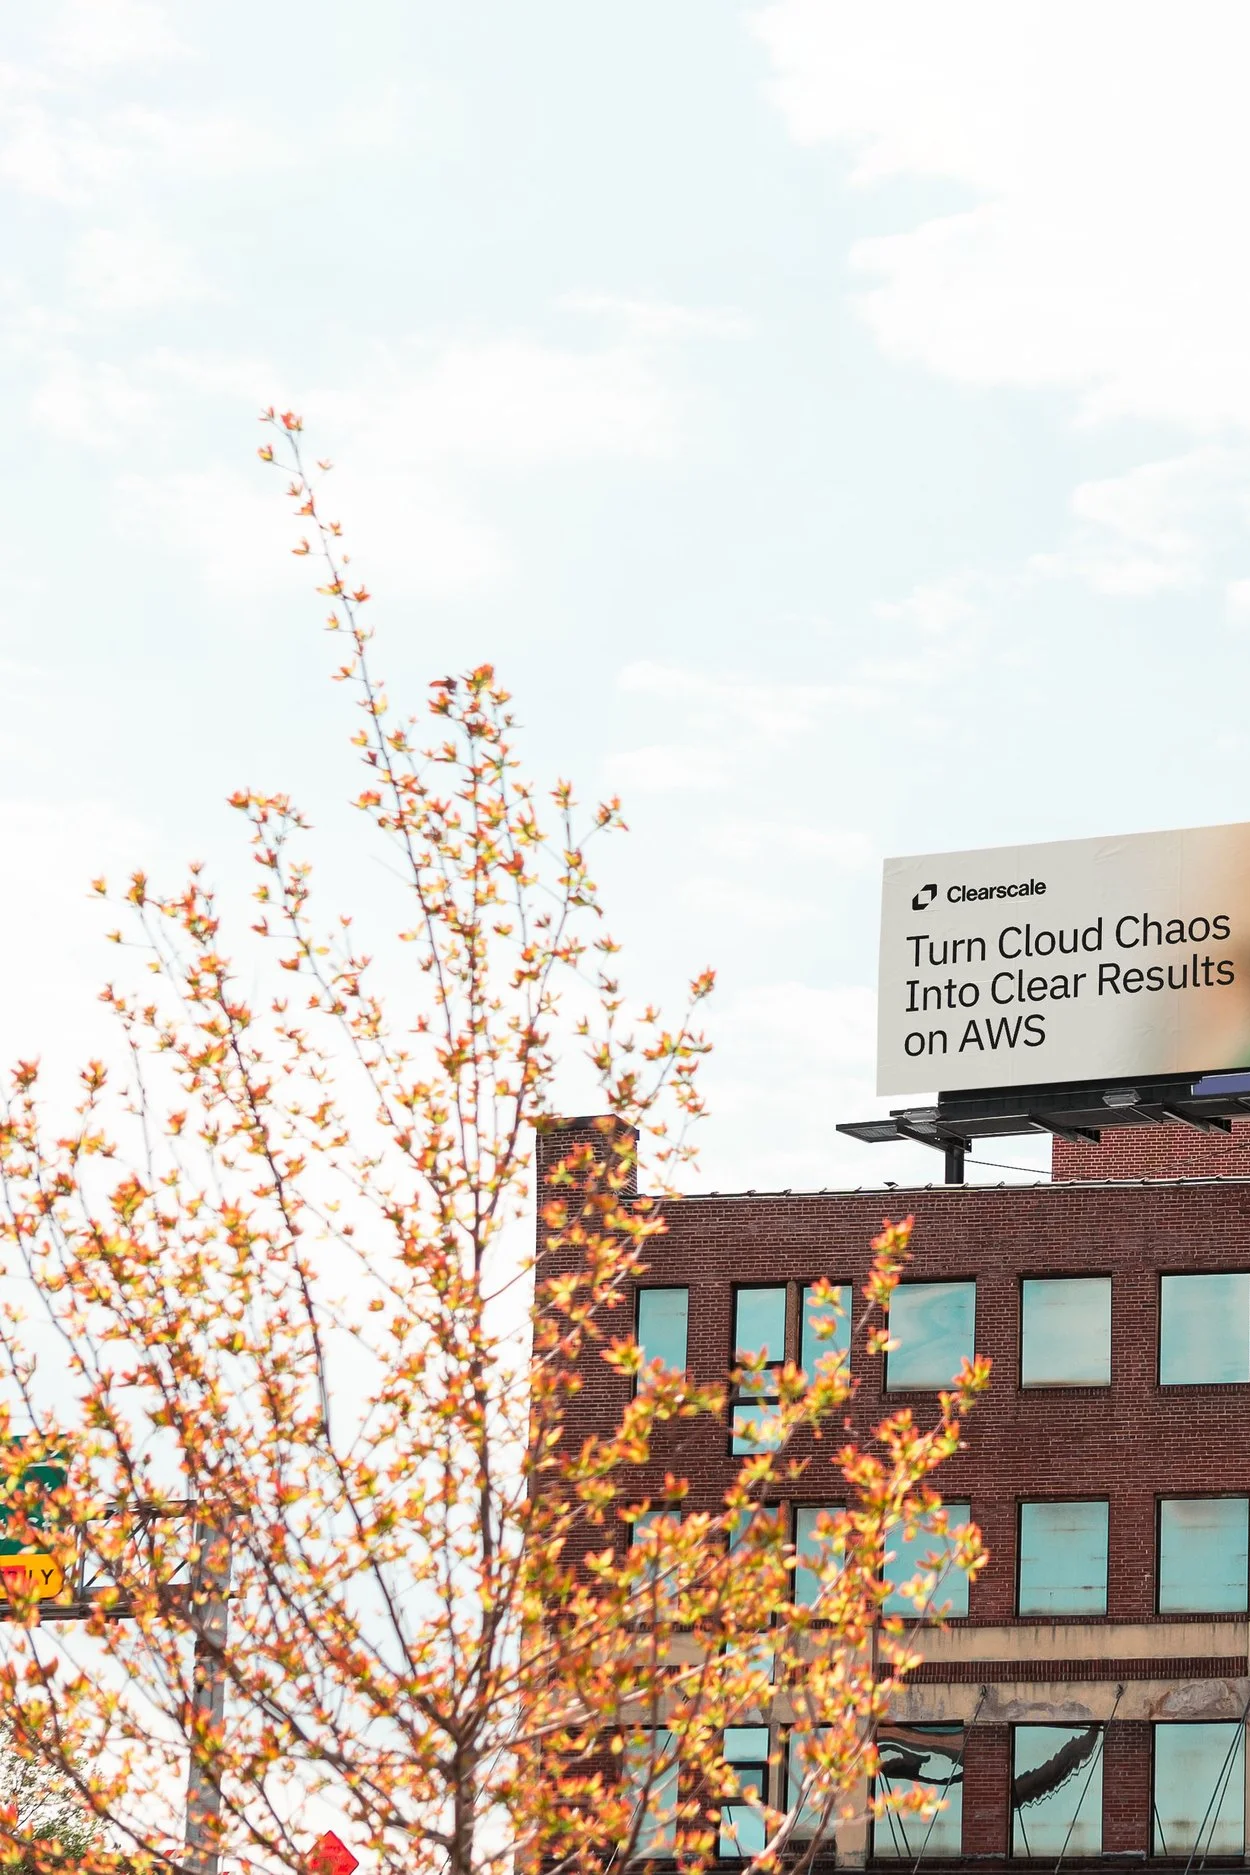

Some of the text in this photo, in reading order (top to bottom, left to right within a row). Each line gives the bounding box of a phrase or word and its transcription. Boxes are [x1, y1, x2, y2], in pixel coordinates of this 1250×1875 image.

[947, 879, 1047, 903] Clearscale
[906, 913, 1231, 967] Turn Cloud Chaos
[905, 953, 1235, 1012] Into Clear Results
[904, 1014, 1046, 1057] on AWS
